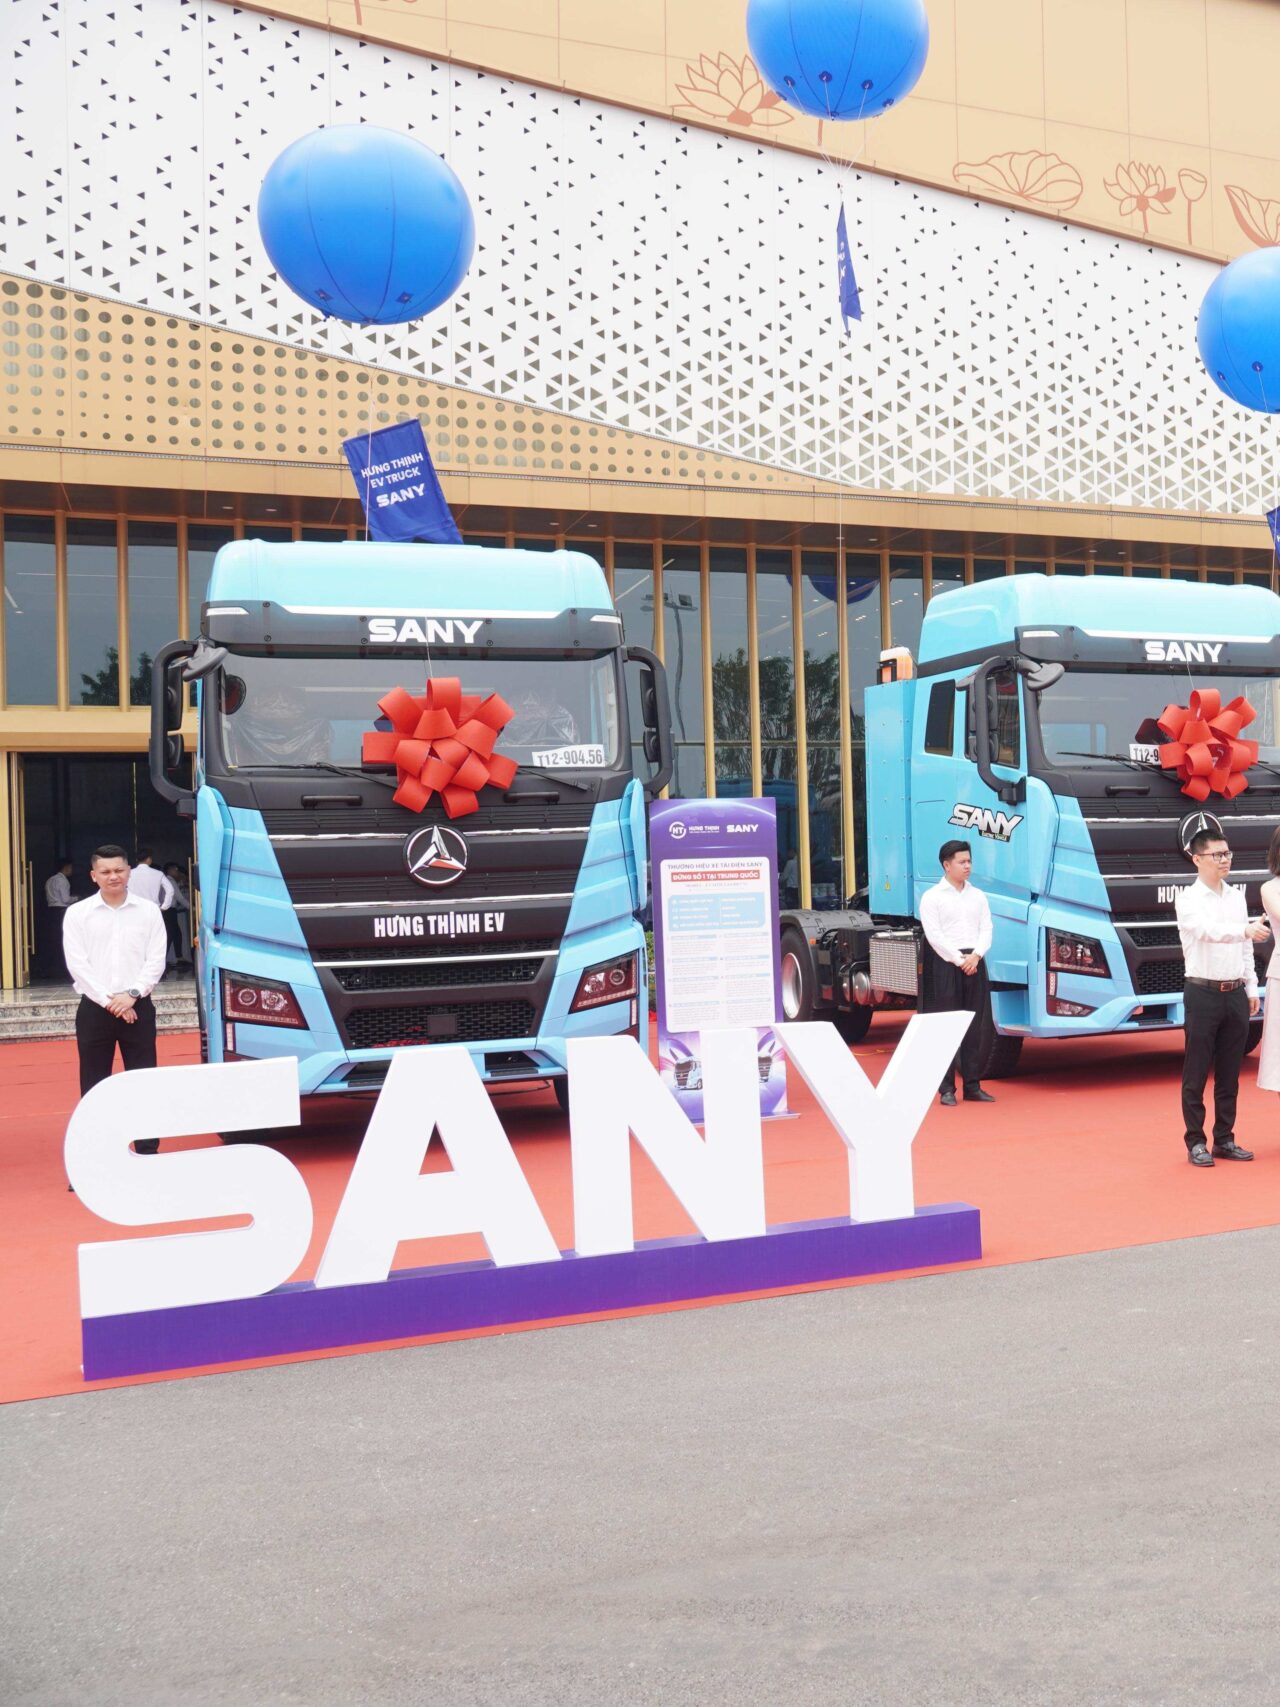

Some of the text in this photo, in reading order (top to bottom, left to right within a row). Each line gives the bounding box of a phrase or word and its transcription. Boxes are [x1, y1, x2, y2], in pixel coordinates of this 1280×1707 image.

[390, 452, 424, 468] THỊNH
[370, 466, 422, 489] EV TRUCK
[376, 483, 425, 508] SANY
[368, 618, 484, 644] SANY
[1145, 641, 1223, 663] SANY
[537, 747, 604, 767] T12-904.56
[1133, 747, 1161, 763] T12-9
[672, 826, 684, 835] HT
[726, 823, 759, 833] SANY
[947, 803, 1024, 837] SANY
[718, 871, 739, 880] TRUNG
[739, 870, 759, 879] QUỐC
[373, 911, 505, 939] HƯNG THỊNH EV
[64, 1010, 976, 1319] SANY
